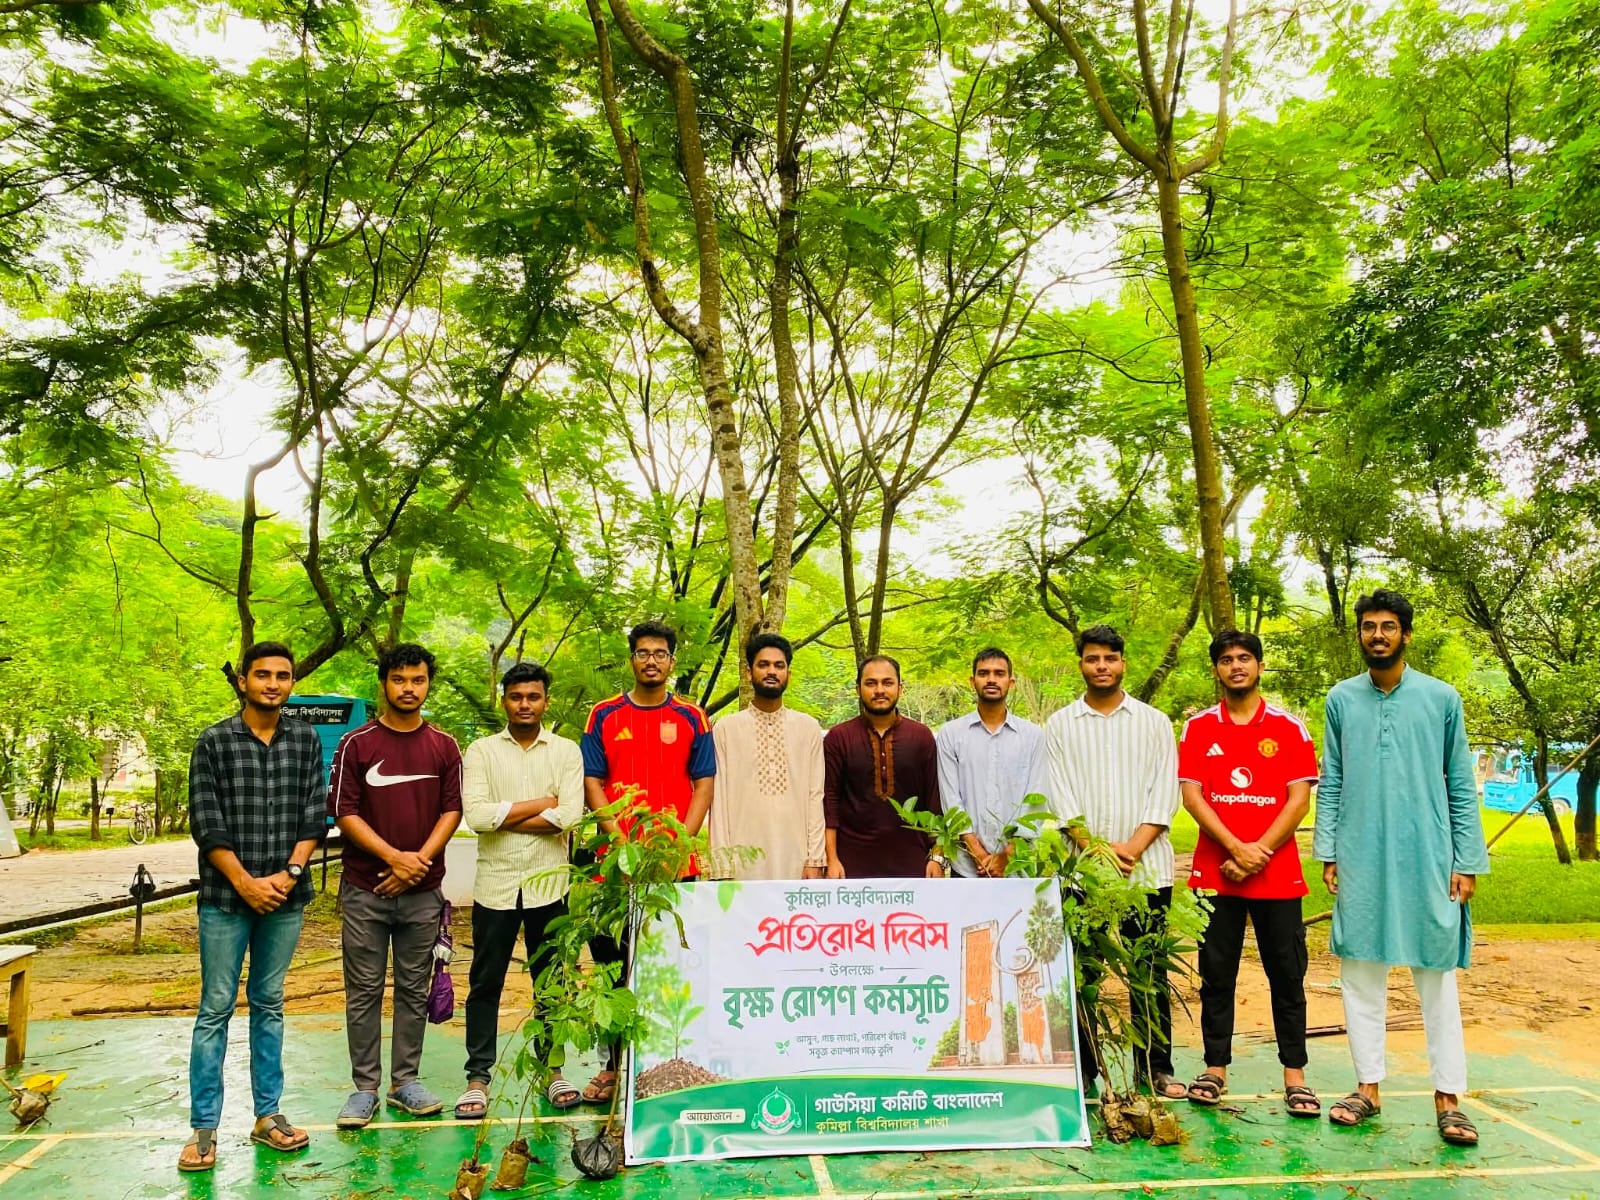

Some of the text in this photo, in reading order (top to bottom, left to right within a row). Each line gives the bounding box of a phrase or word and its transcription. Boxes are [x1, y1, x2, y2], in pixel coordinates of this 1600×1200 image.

[1211, 792, 1276, 806] Snapdragon
[784, 886, 914, 911] কুমিল্লা বিশ্ববিদ্যালয়
[746, 912, 949, 957] প্রতিরোধ দিবস
[829, 962, 875, 977] উপলক্ষে
[723, 974, 950, 1030] বৃক্ষ রোপণ কর্মসূচি
[809, 1047, 828, 1059] সবুজ
[815, 1089, 1004, 1115] গাউসিয়া কমিটি বাংলাদেশ
[686, 1110, 733, 1122] আয়োজনে
[816, 1117, 852, 1136] কুমিল্লা
[856, 1116, 920, 1133] বিশ্ববিদ্যালয়
[923, 1115, 949, 1129] শাখা
